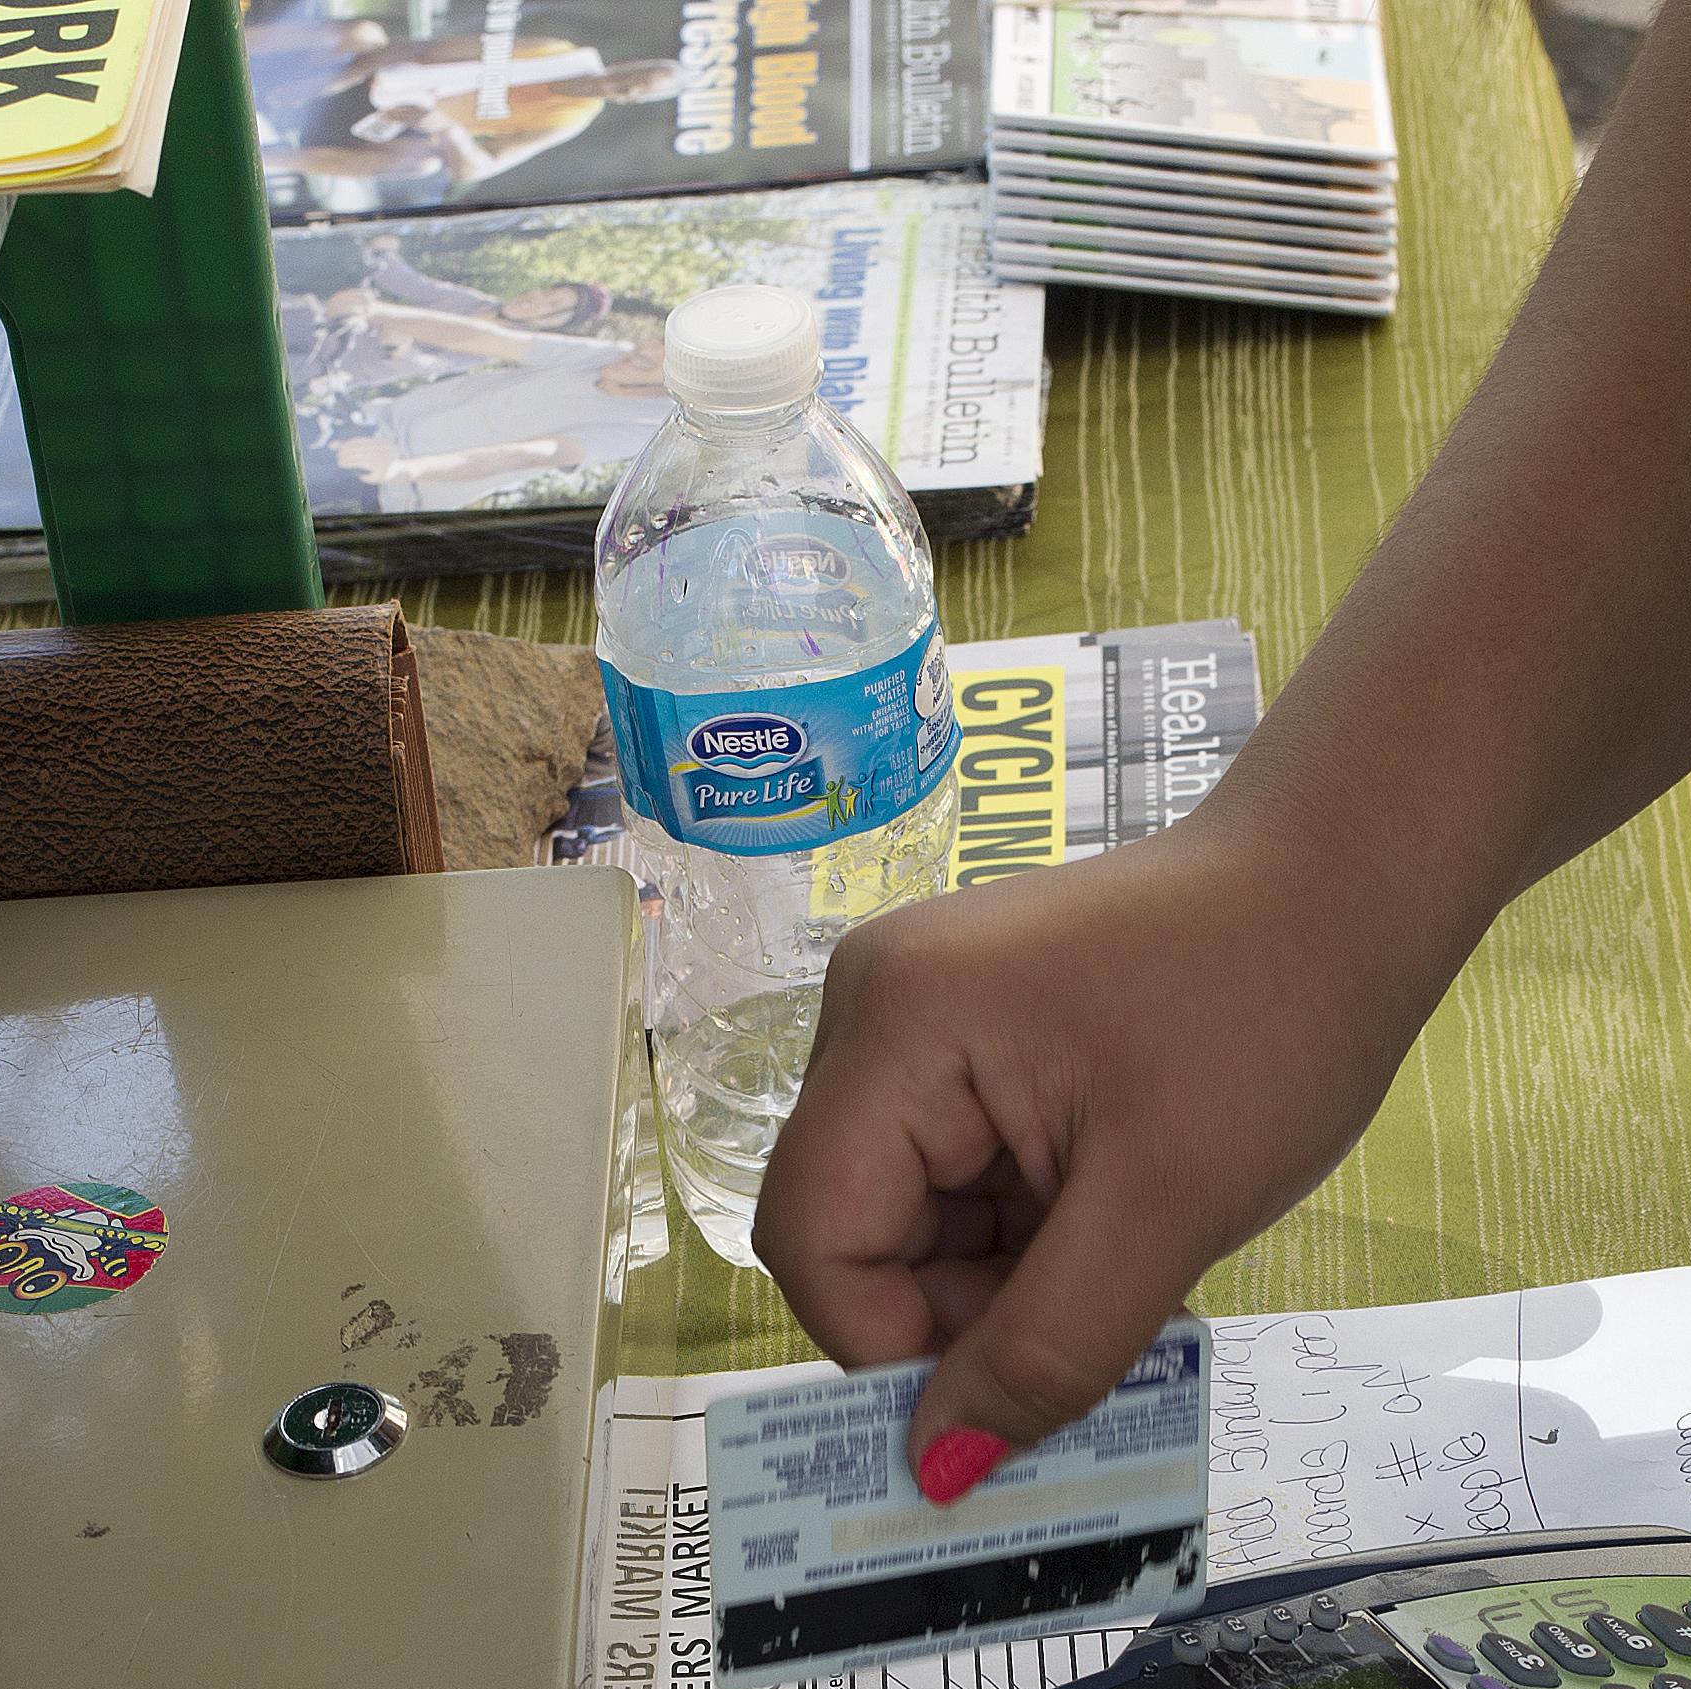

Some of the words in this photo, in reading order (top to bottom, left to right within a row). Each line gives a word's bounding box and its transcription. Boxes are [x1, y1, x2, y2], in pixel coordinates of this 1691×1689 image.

[749, 50, 820, 150] Blood
[902, 42, 953, 157] Bulletin
[817, 227, 883, 301] Living
[939, 334, 1000, 468] Bulletin
[863, 670, 906, 698] PURIFIED
[876, 682, 908, 706] WATER
[871, 694, 909, 720] ENHANCED
[874, 705, 911, 729] MINERALS
[703, 726, 791, 755] Nestlé
[1160, 652, 1221, 802] Health
[694, 783, 760, 810] Pure
[762, 772, 815, 803] Life
[1435, 1431, 1524, 1534] eople
[670, 1483, 711, 1620] MARKET
[1271, 1606, 1293, 1623] F3
[1601, 1616, 1634, 1641] WXY
[1496, 1638, 1521, 1659] DEF
[1547, 1624, 1579, 1650] MNO
